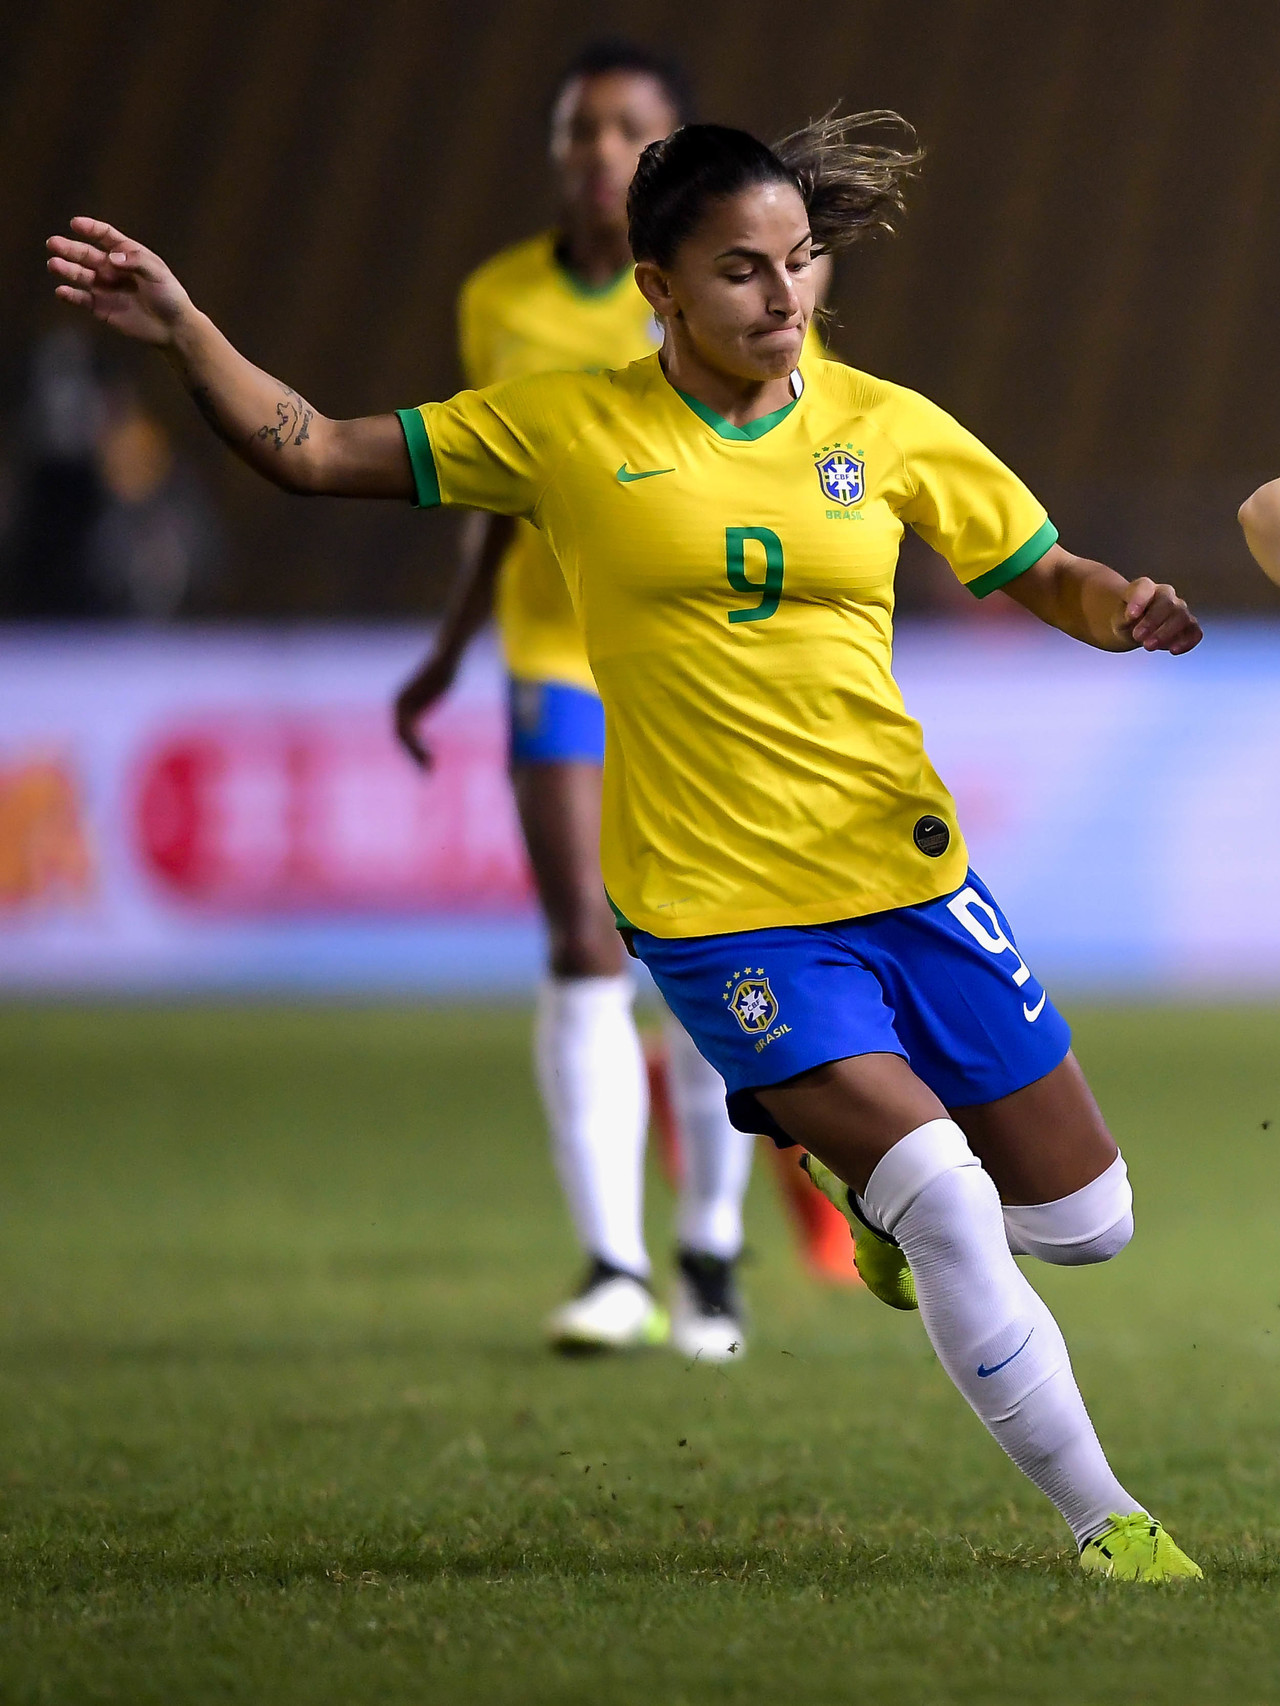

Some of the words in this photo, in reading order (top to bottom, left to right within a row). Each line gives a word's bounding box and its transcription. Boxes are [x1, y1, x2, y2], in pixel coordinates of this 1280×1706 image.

[825, 509, 864, 520] BRASIL
[725, 527, 784, 624] 9
[946, 887, 1031, 987] 9
[747, 998, 760, 1012] CBF
[754, 1023, 792, 1054] BRASIL
